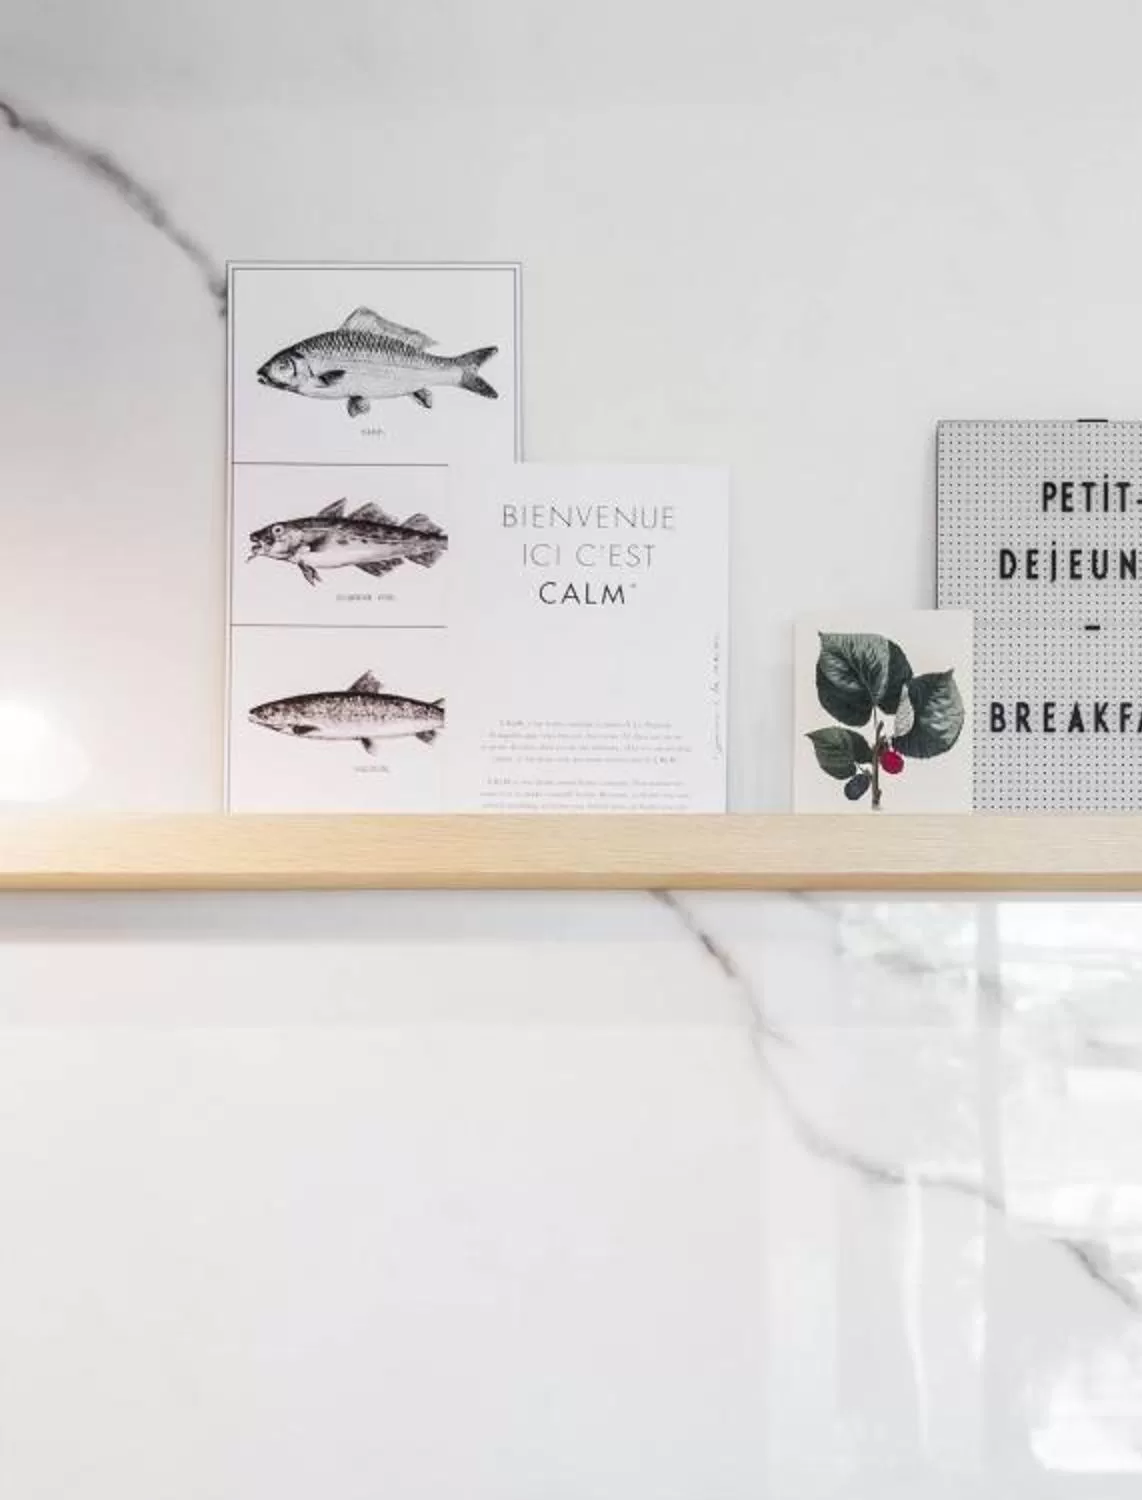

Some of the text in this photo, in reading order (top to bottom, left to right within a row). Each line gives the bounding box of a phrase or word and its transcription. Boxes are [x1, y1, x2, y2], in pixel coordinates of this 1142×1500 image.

[502, 503, 676, 529] BIENVENUE
[523, 543, 656, 568] ICI C'EST
